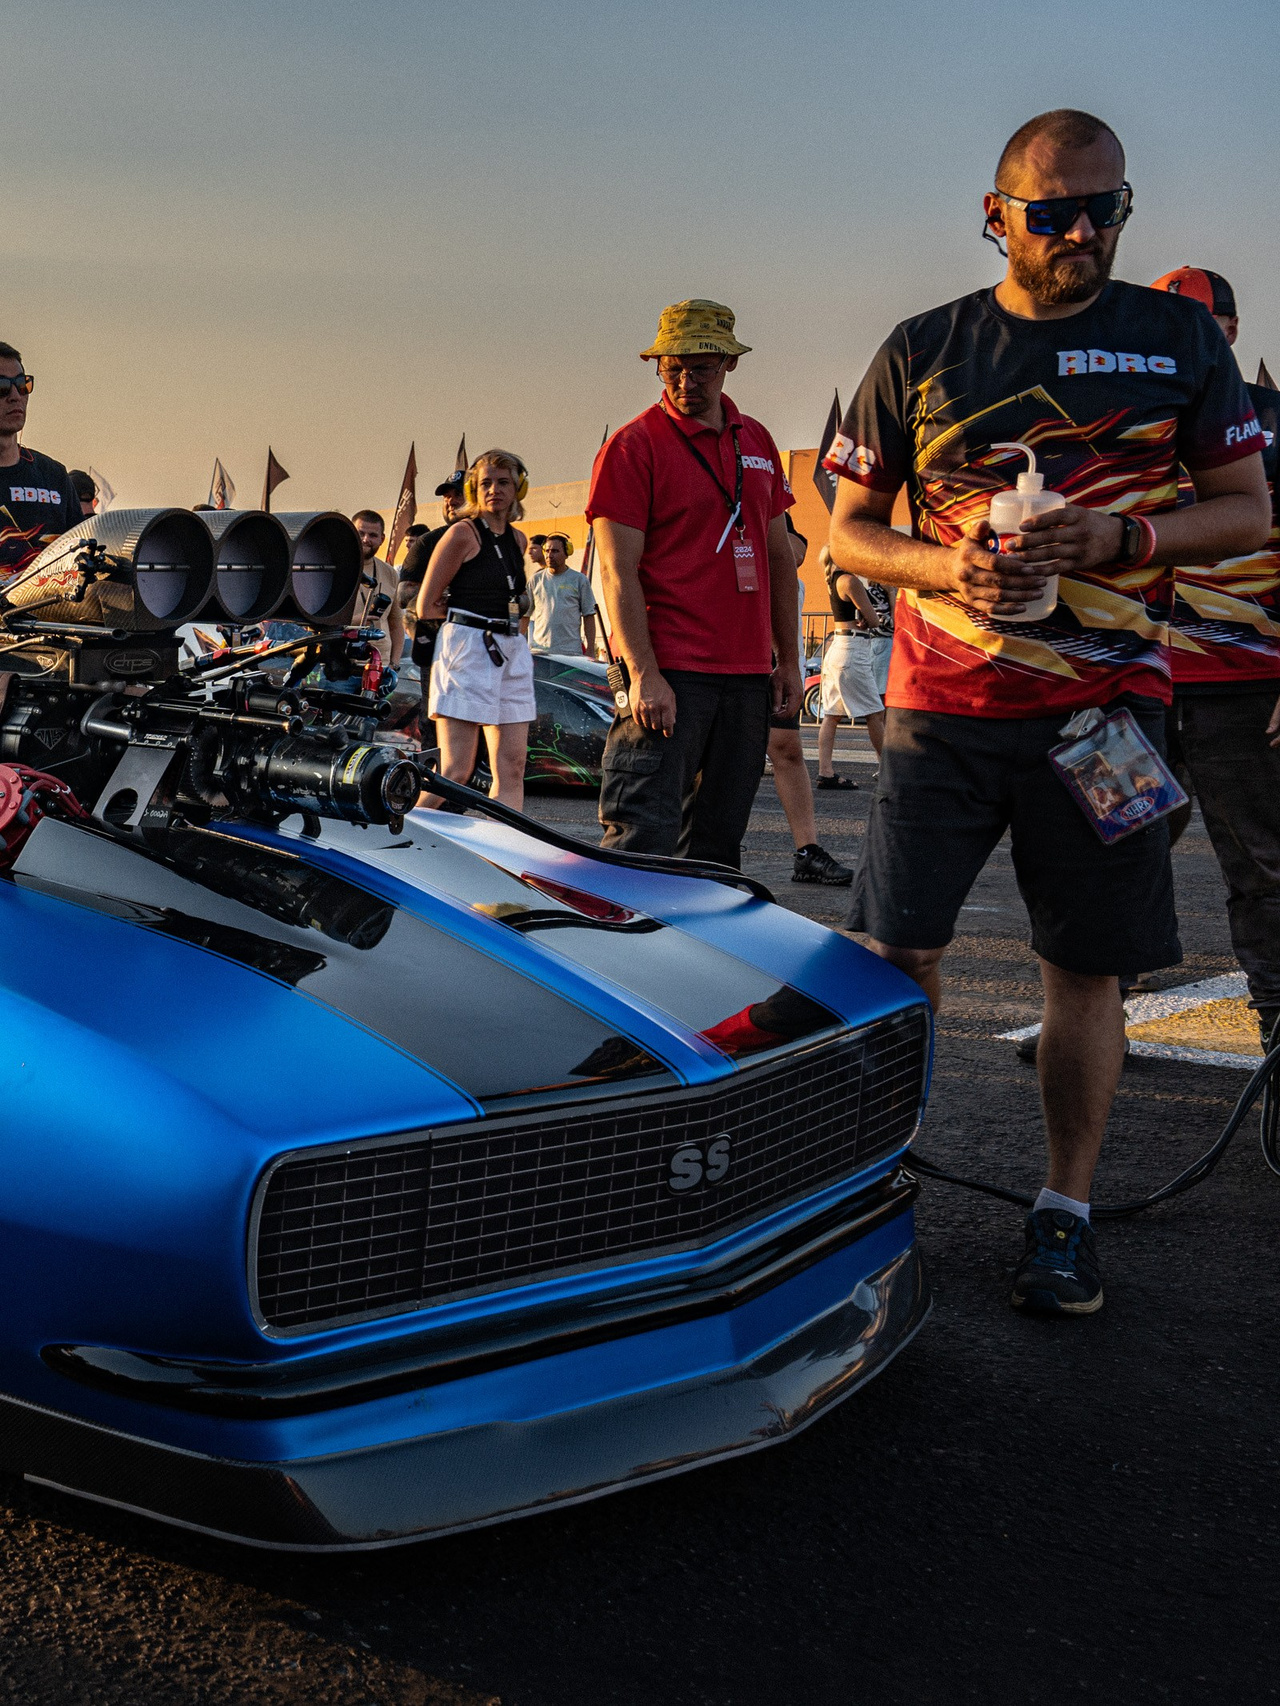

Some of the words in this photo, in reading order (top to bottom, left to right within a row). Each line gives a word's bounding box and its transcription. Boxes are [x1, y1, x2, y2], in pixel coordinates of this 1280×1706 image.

[1056, 348, 1177, 376] RDRC
[741, 455, 775, 475] RDRC
[9, 486, 61, 505] RDRC
[735, 546, 752, 554] 2024
[1125, 800, 1150, 817] NHRA
[669, 1139, 730, 1190] SS
